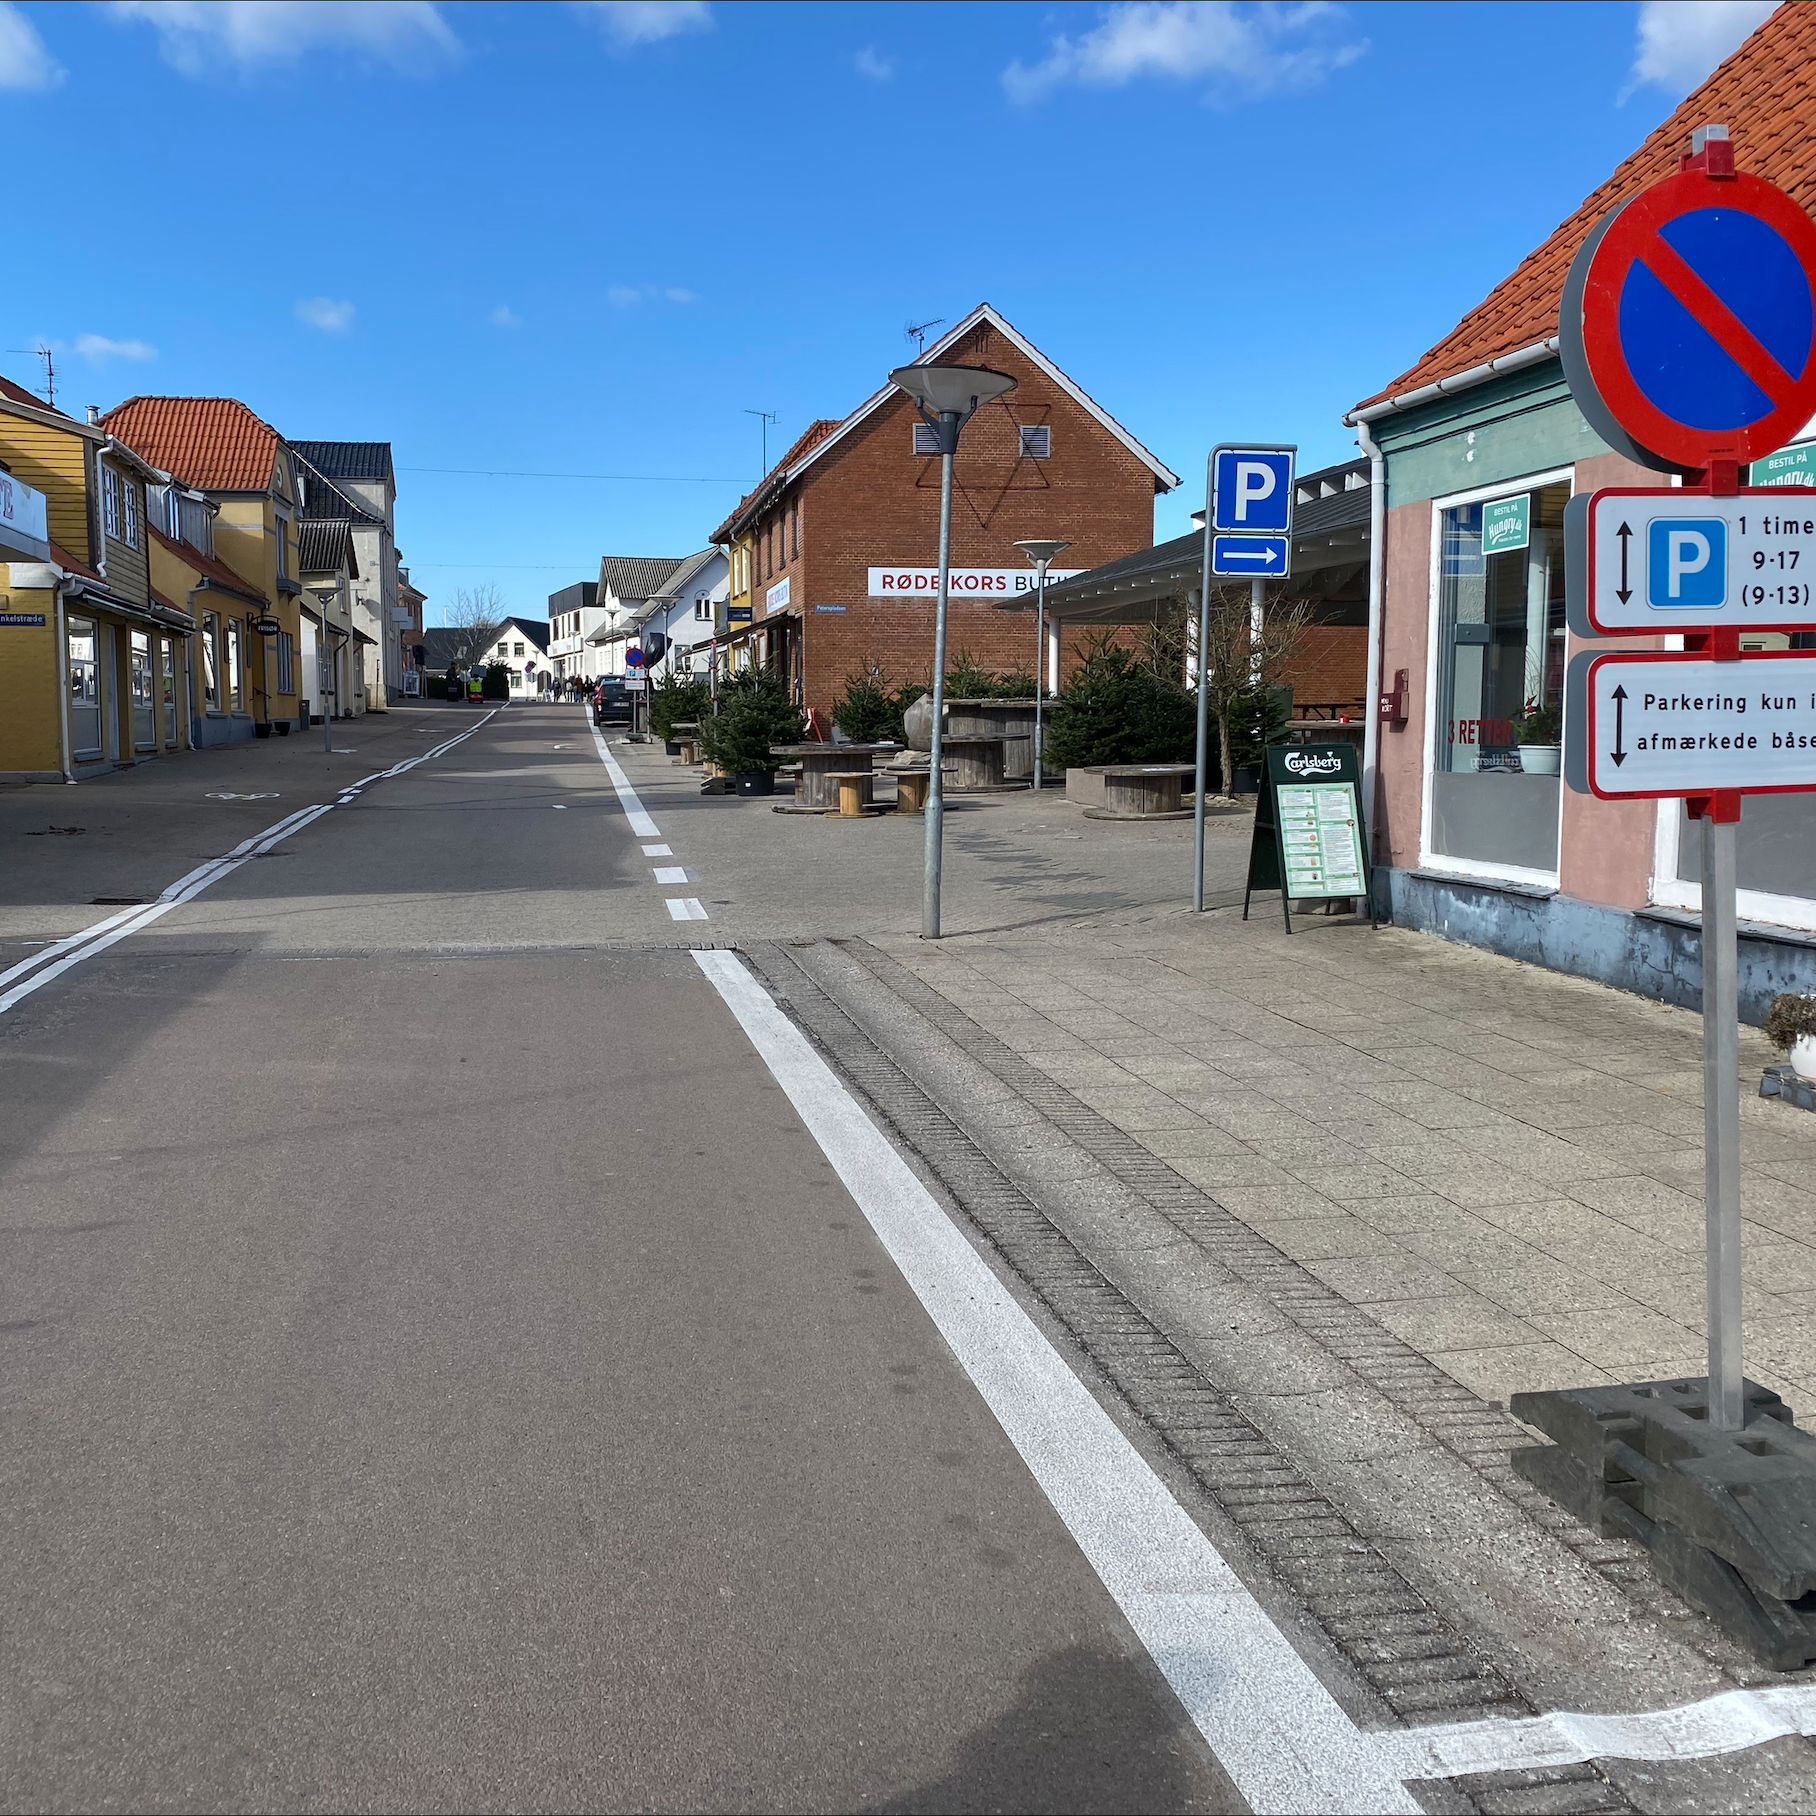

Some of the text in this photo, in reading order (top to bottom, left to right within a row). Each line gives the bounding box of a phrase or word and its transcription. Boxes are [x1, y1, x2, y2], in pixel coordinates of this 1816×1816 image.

[1768, 451, 1808, 470] BESTIL PÅ
[1235, 462, 1276, 520] P
[1738, 516, 1815, 535] 1 time
[1668, 530, 1711, 598] P
[1752, 551, 1800, 570] 9-17
[882, 574, 939, 590] RØDE
[951, 574, 1007, 591] KORS
[1742, 584, 1809, 608] (9-13)
[1643, 693, 1816, 714] Parkering kun i
[1447, 720, 1455, 745] 3
[1637, 731, 1816, 750] afmærkede båse
[1284, 751, 1342, 776] Carlsberg
